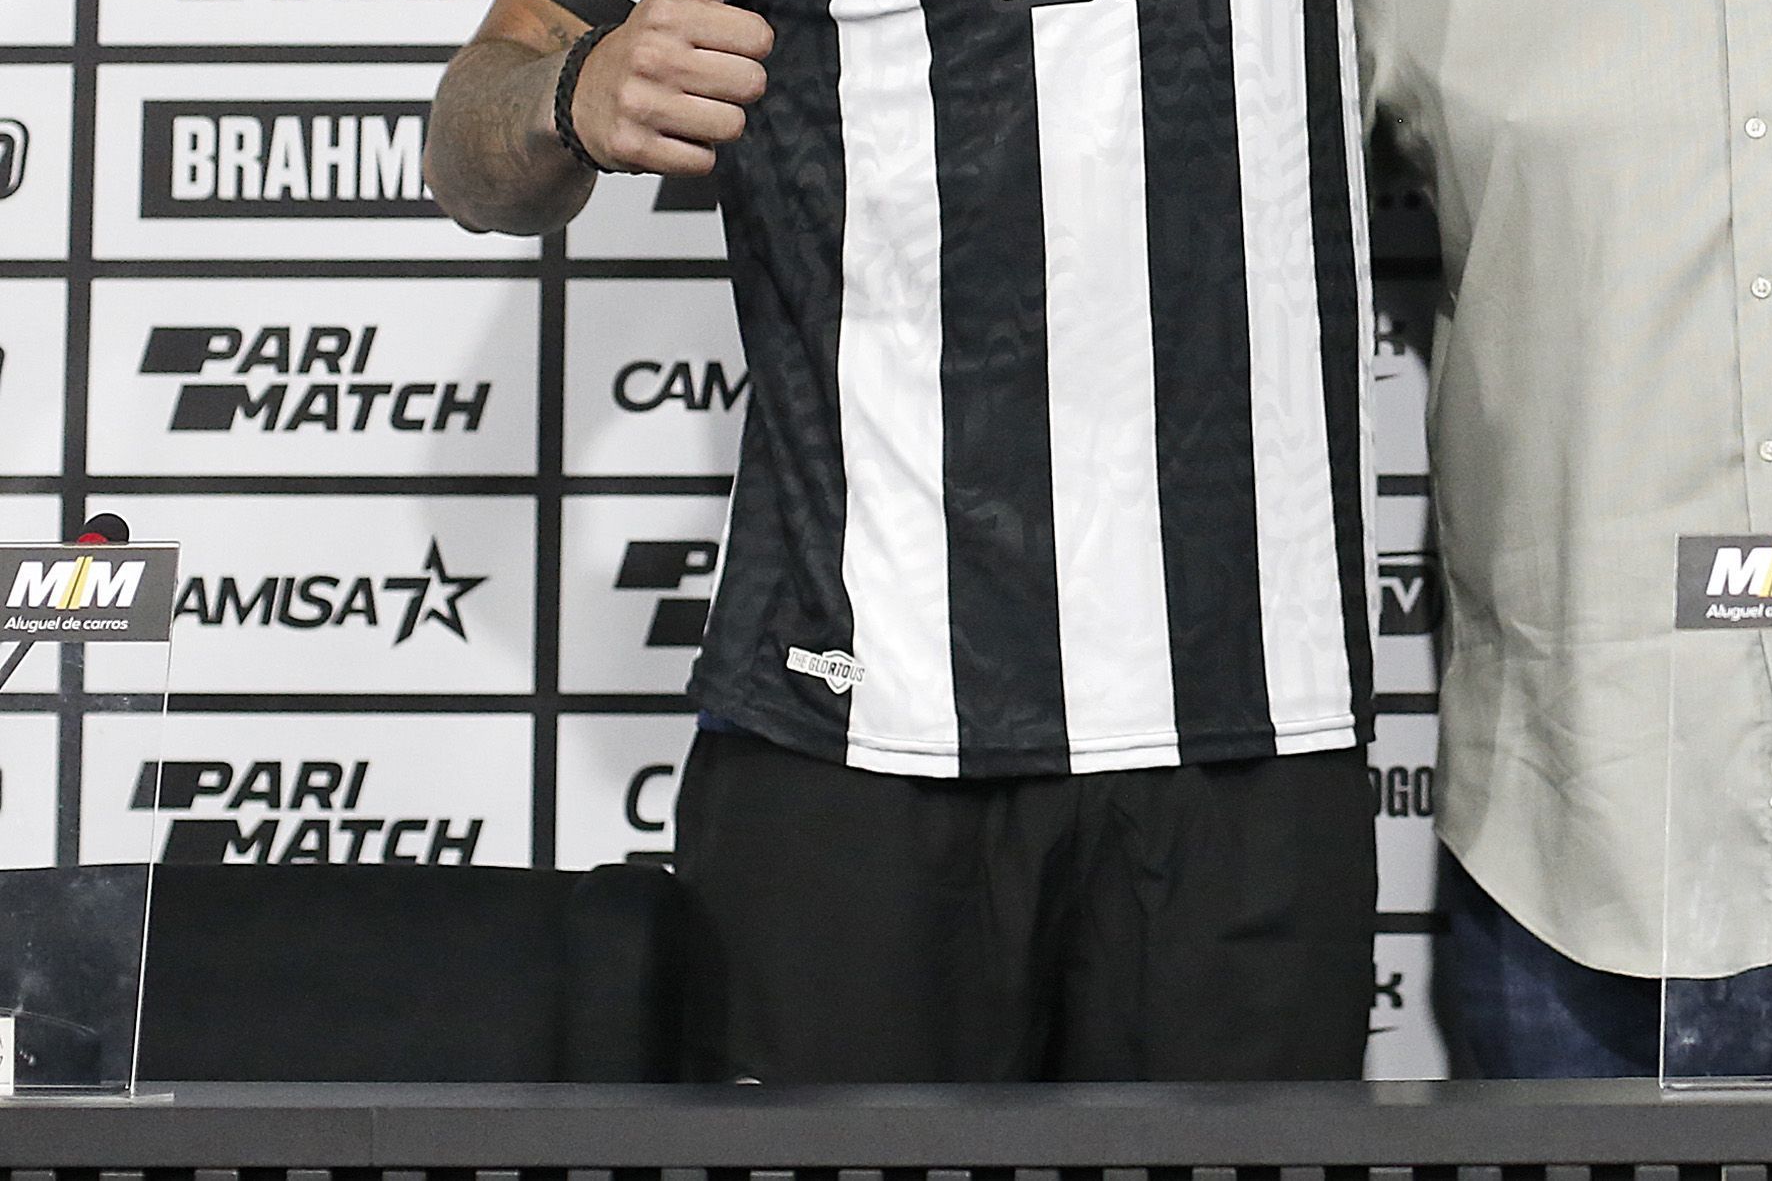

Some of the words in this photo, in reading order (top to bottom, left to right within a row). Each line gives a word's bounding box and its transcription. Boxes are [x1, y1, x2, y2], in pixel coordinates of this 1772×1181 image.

[171, 115, 434, 201] BRAHM
[191, 325, 378, 375] PARI
[224, 381, 492, 432] MATCH
[4, 616, 60, 633] Aluguel
[62, 617, 80, 630] de
[82, 619, 128, 630] carros
[173, 576, 488, 648] AMISA7
[1705, 604, 1763, 621] Aluguel
[180, 761, 369, 811] PARI
[214, 818, 484, 865] MATCH
